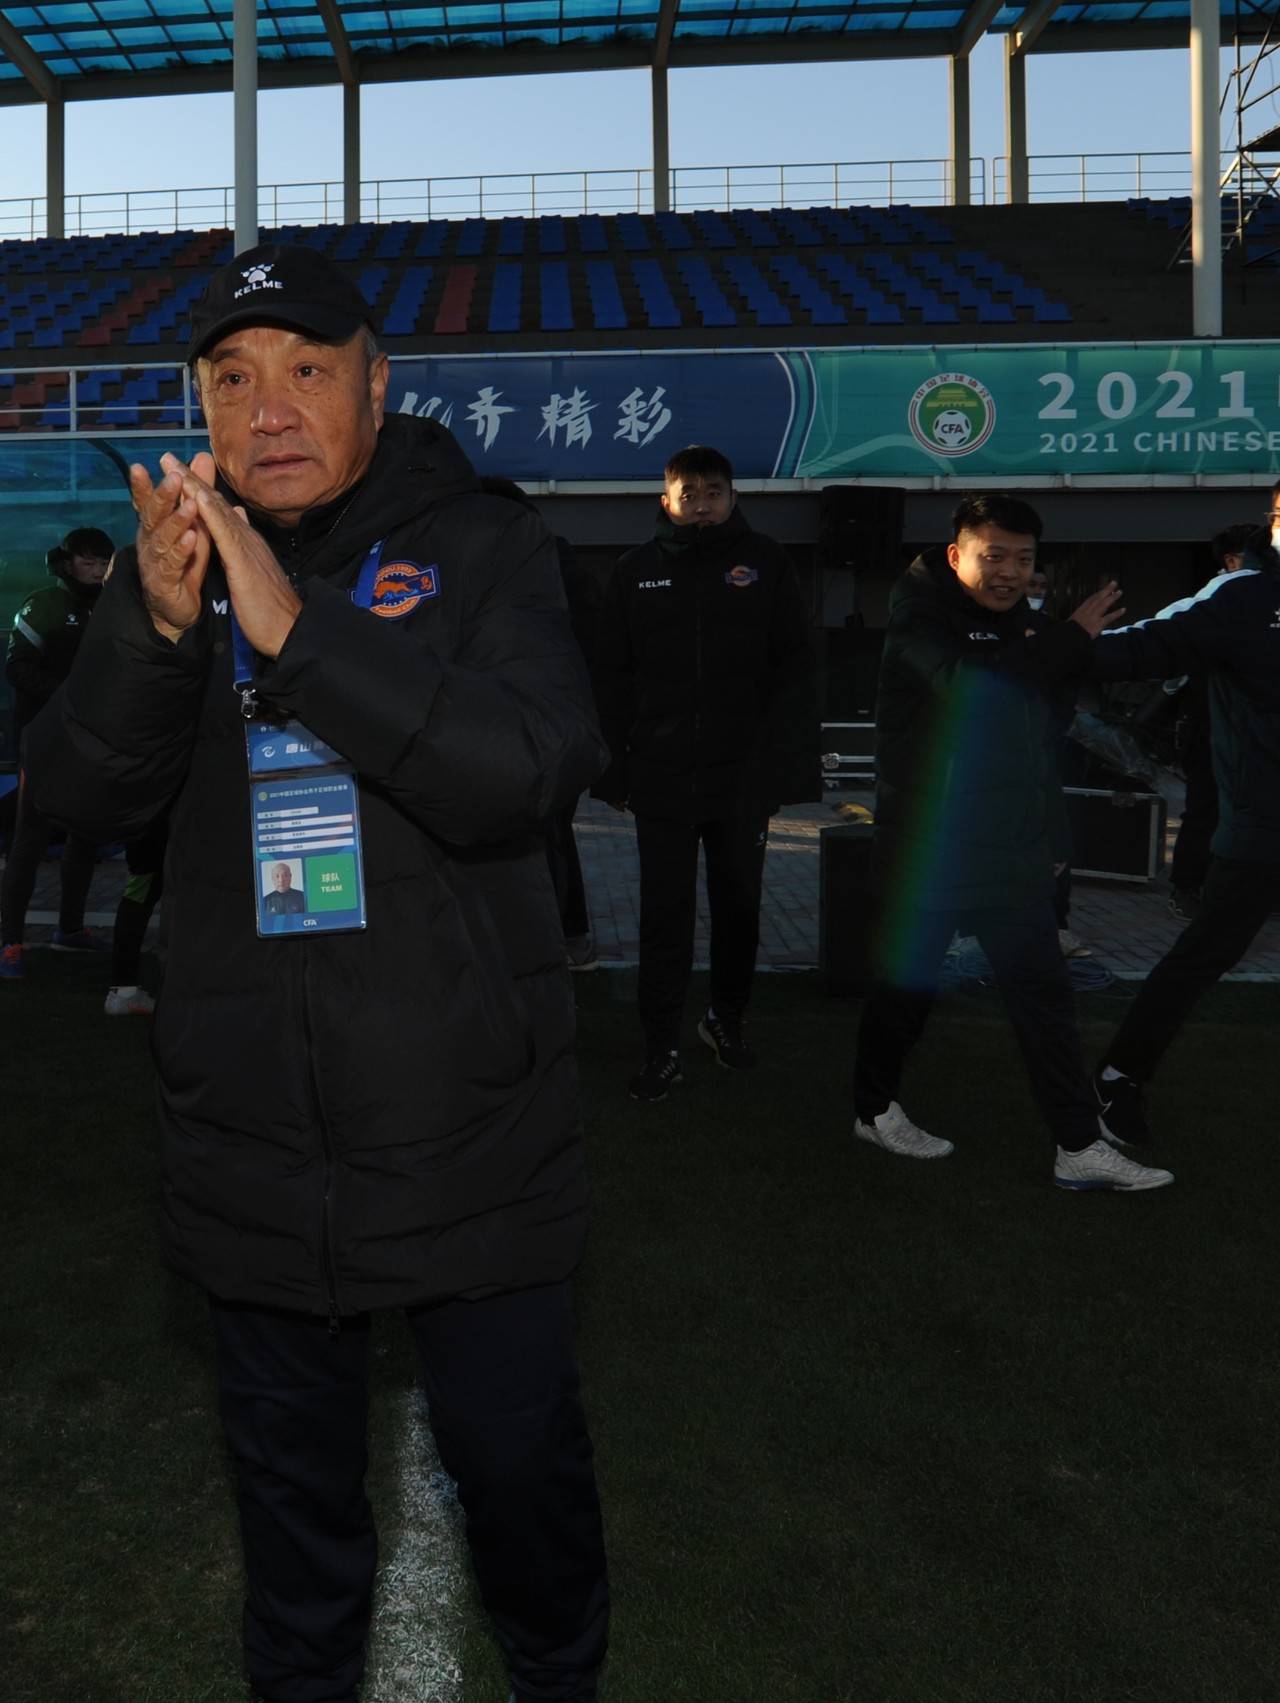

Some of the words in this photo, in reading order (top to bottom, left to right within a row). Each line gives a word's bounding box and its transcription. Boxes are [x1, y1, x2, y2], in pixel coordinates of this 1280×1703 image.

[234, 280, 284, 299] KELME
[1038, 370, 1255, 420] 2021
[940, 423, 964, 434] CFA
[1039, 432, 1119, 453] 2021
[1133, 431, 1280, 452] CHINESE
[638, 579, 672, 589] KELME
[321, 885, 343, 893] TEAM
